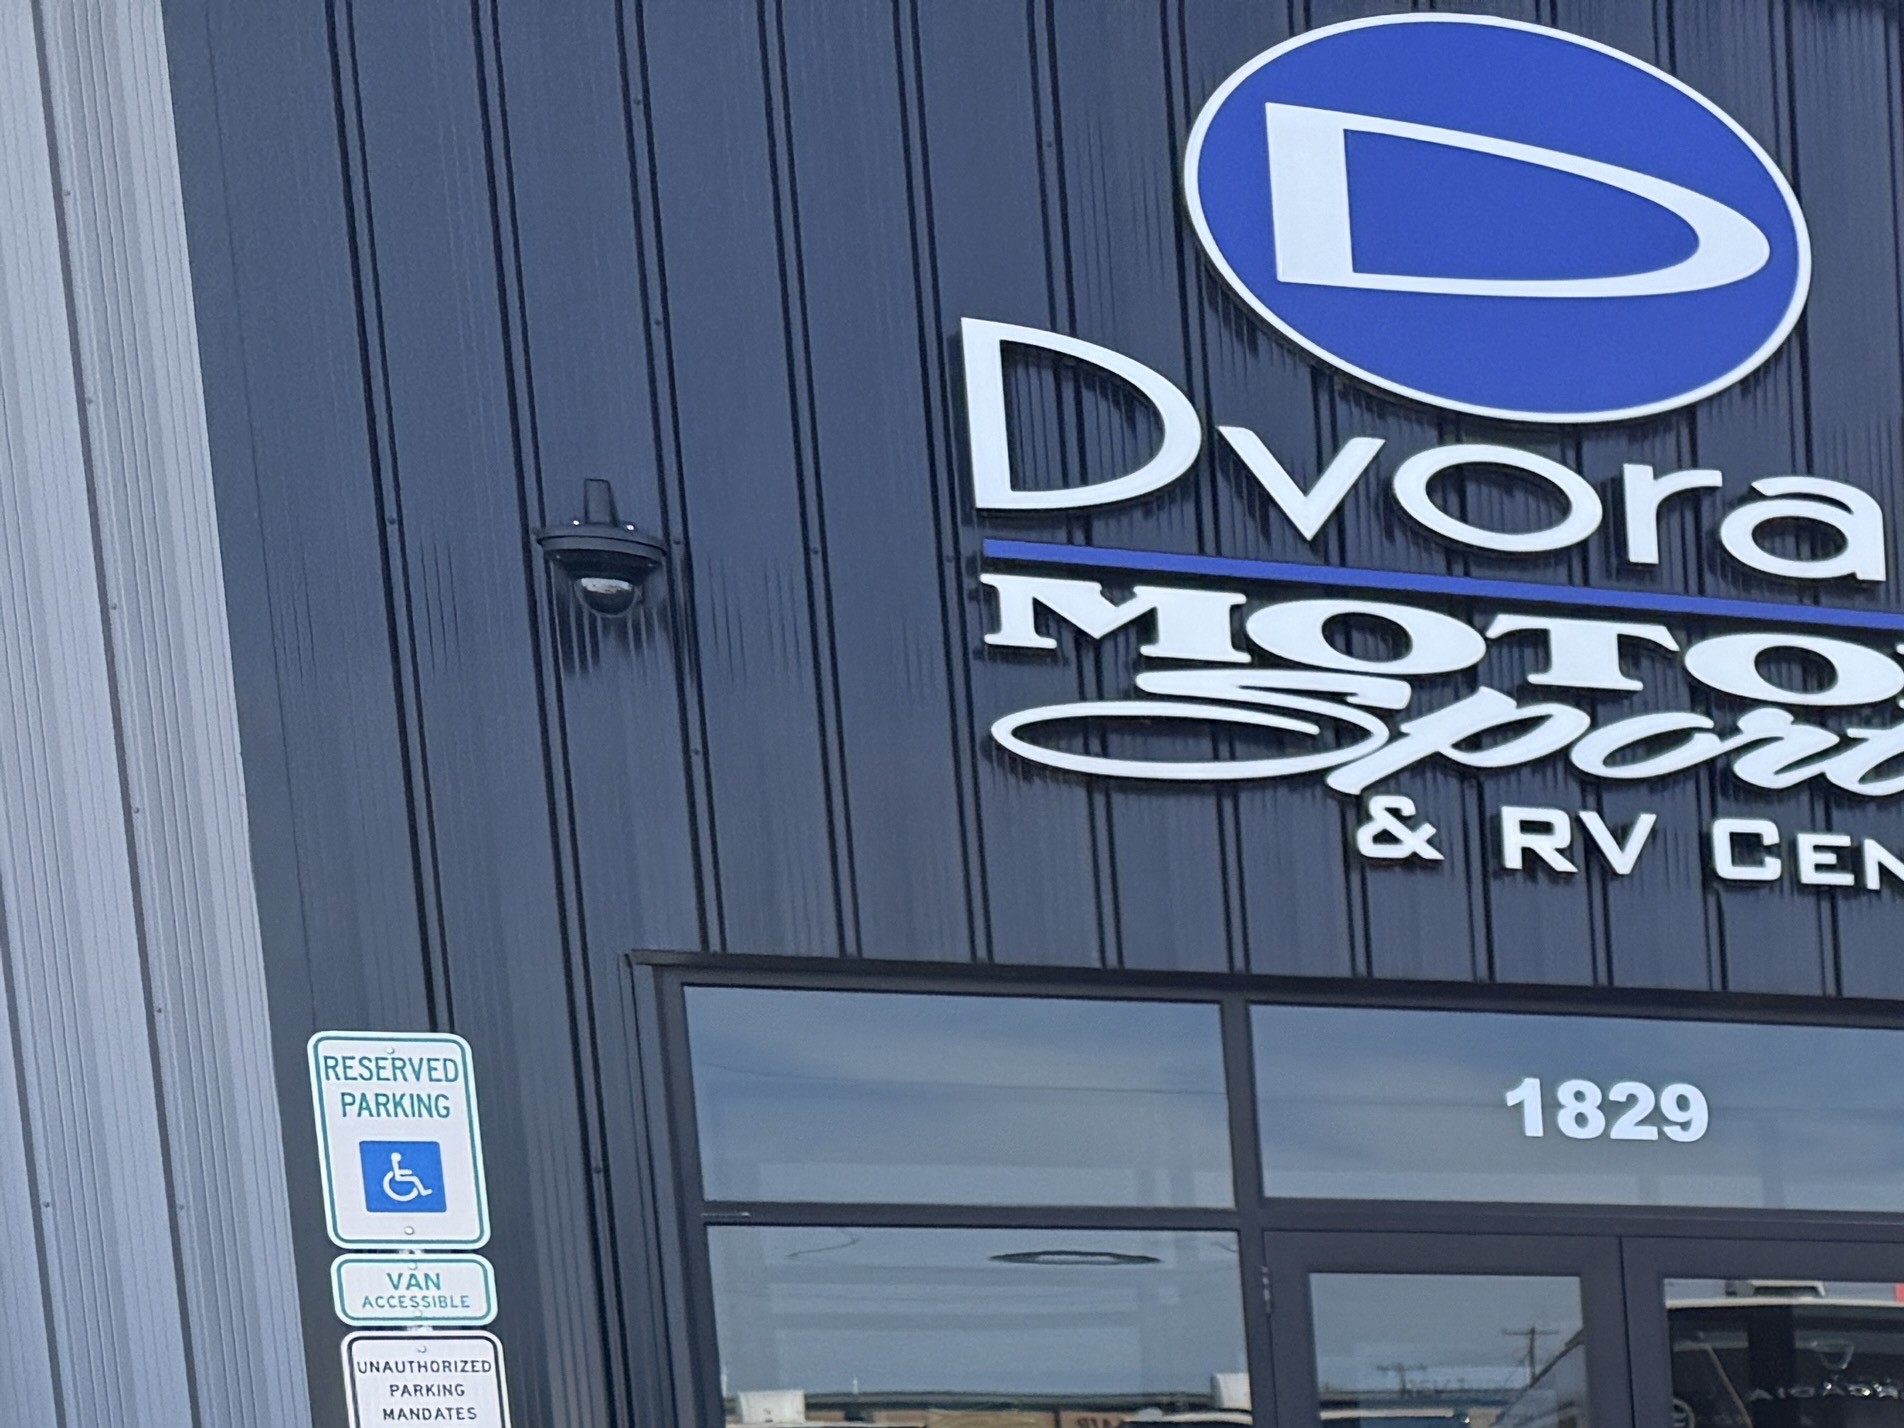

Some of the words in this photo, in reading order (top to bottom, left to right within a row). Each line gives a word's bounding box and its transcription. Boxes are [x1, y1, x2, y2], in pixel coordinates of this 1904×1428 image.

[1265, 101, 1771, 298] D
[1356, 797, 1443, 861] &
[1501, 805, 1657, 876] RV
[323, 1055, 460, 1084] RESERVED
[341, 1092, 451, 1119] PARKING
[1505, 1077, 1710, 1143] 1829
[386, 1272, 441, 1291] VAN
[361, 1295, 471, 1310] ACCESSIBLE
[356, 1359, 492, 1375] UNAUTHORIZED
[389, 1383, 466, 1398] PARKING
[383, 1406, 478, 1421] MANDATES
